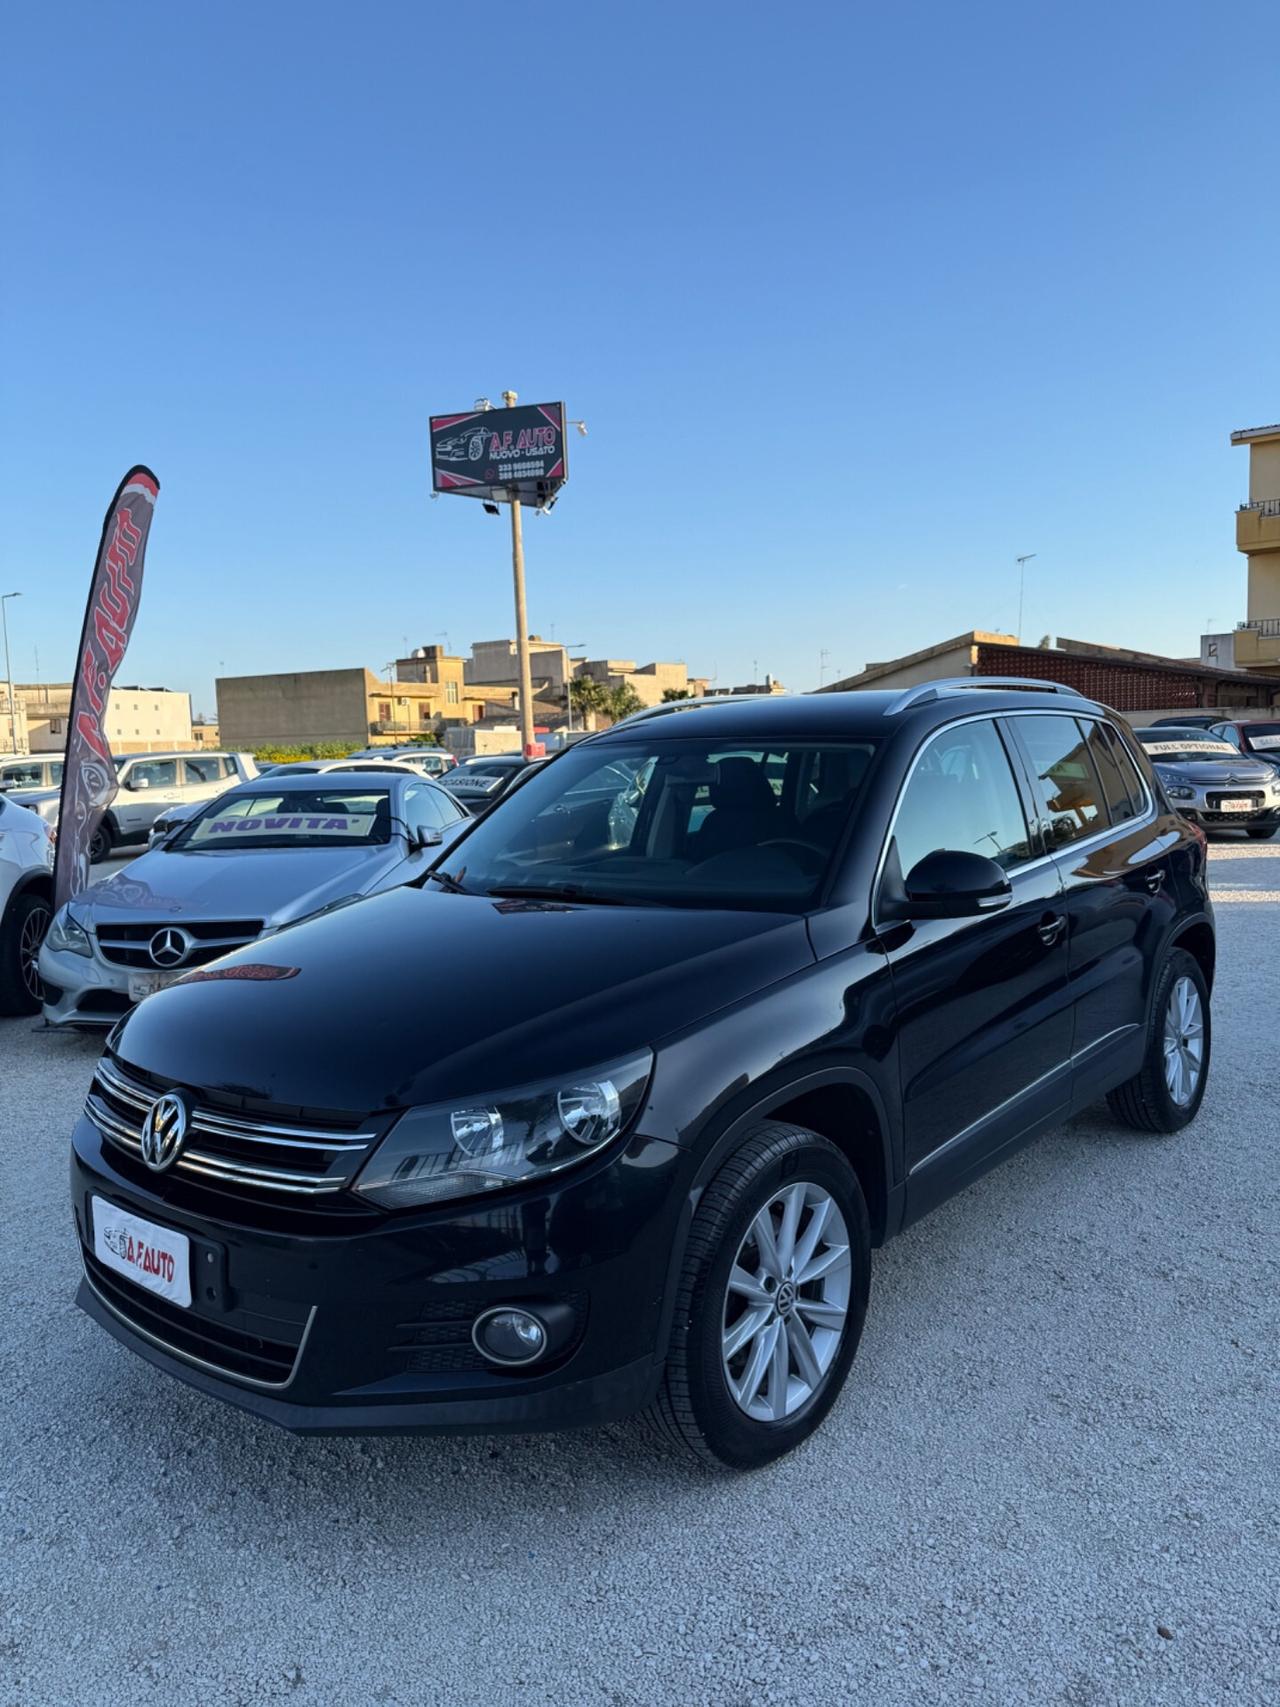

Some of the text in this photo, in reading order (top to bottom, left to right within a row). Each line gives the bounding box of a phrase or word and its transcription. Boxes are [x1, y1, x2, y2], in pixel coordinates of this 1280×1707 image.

[516, 426, 556, 449] AUTO
[489, 449, 521, 460] NUOVO
[525, 445, 555, 456] USATO
[1153, 742, 1229, 751] FULL OPTIONAL
